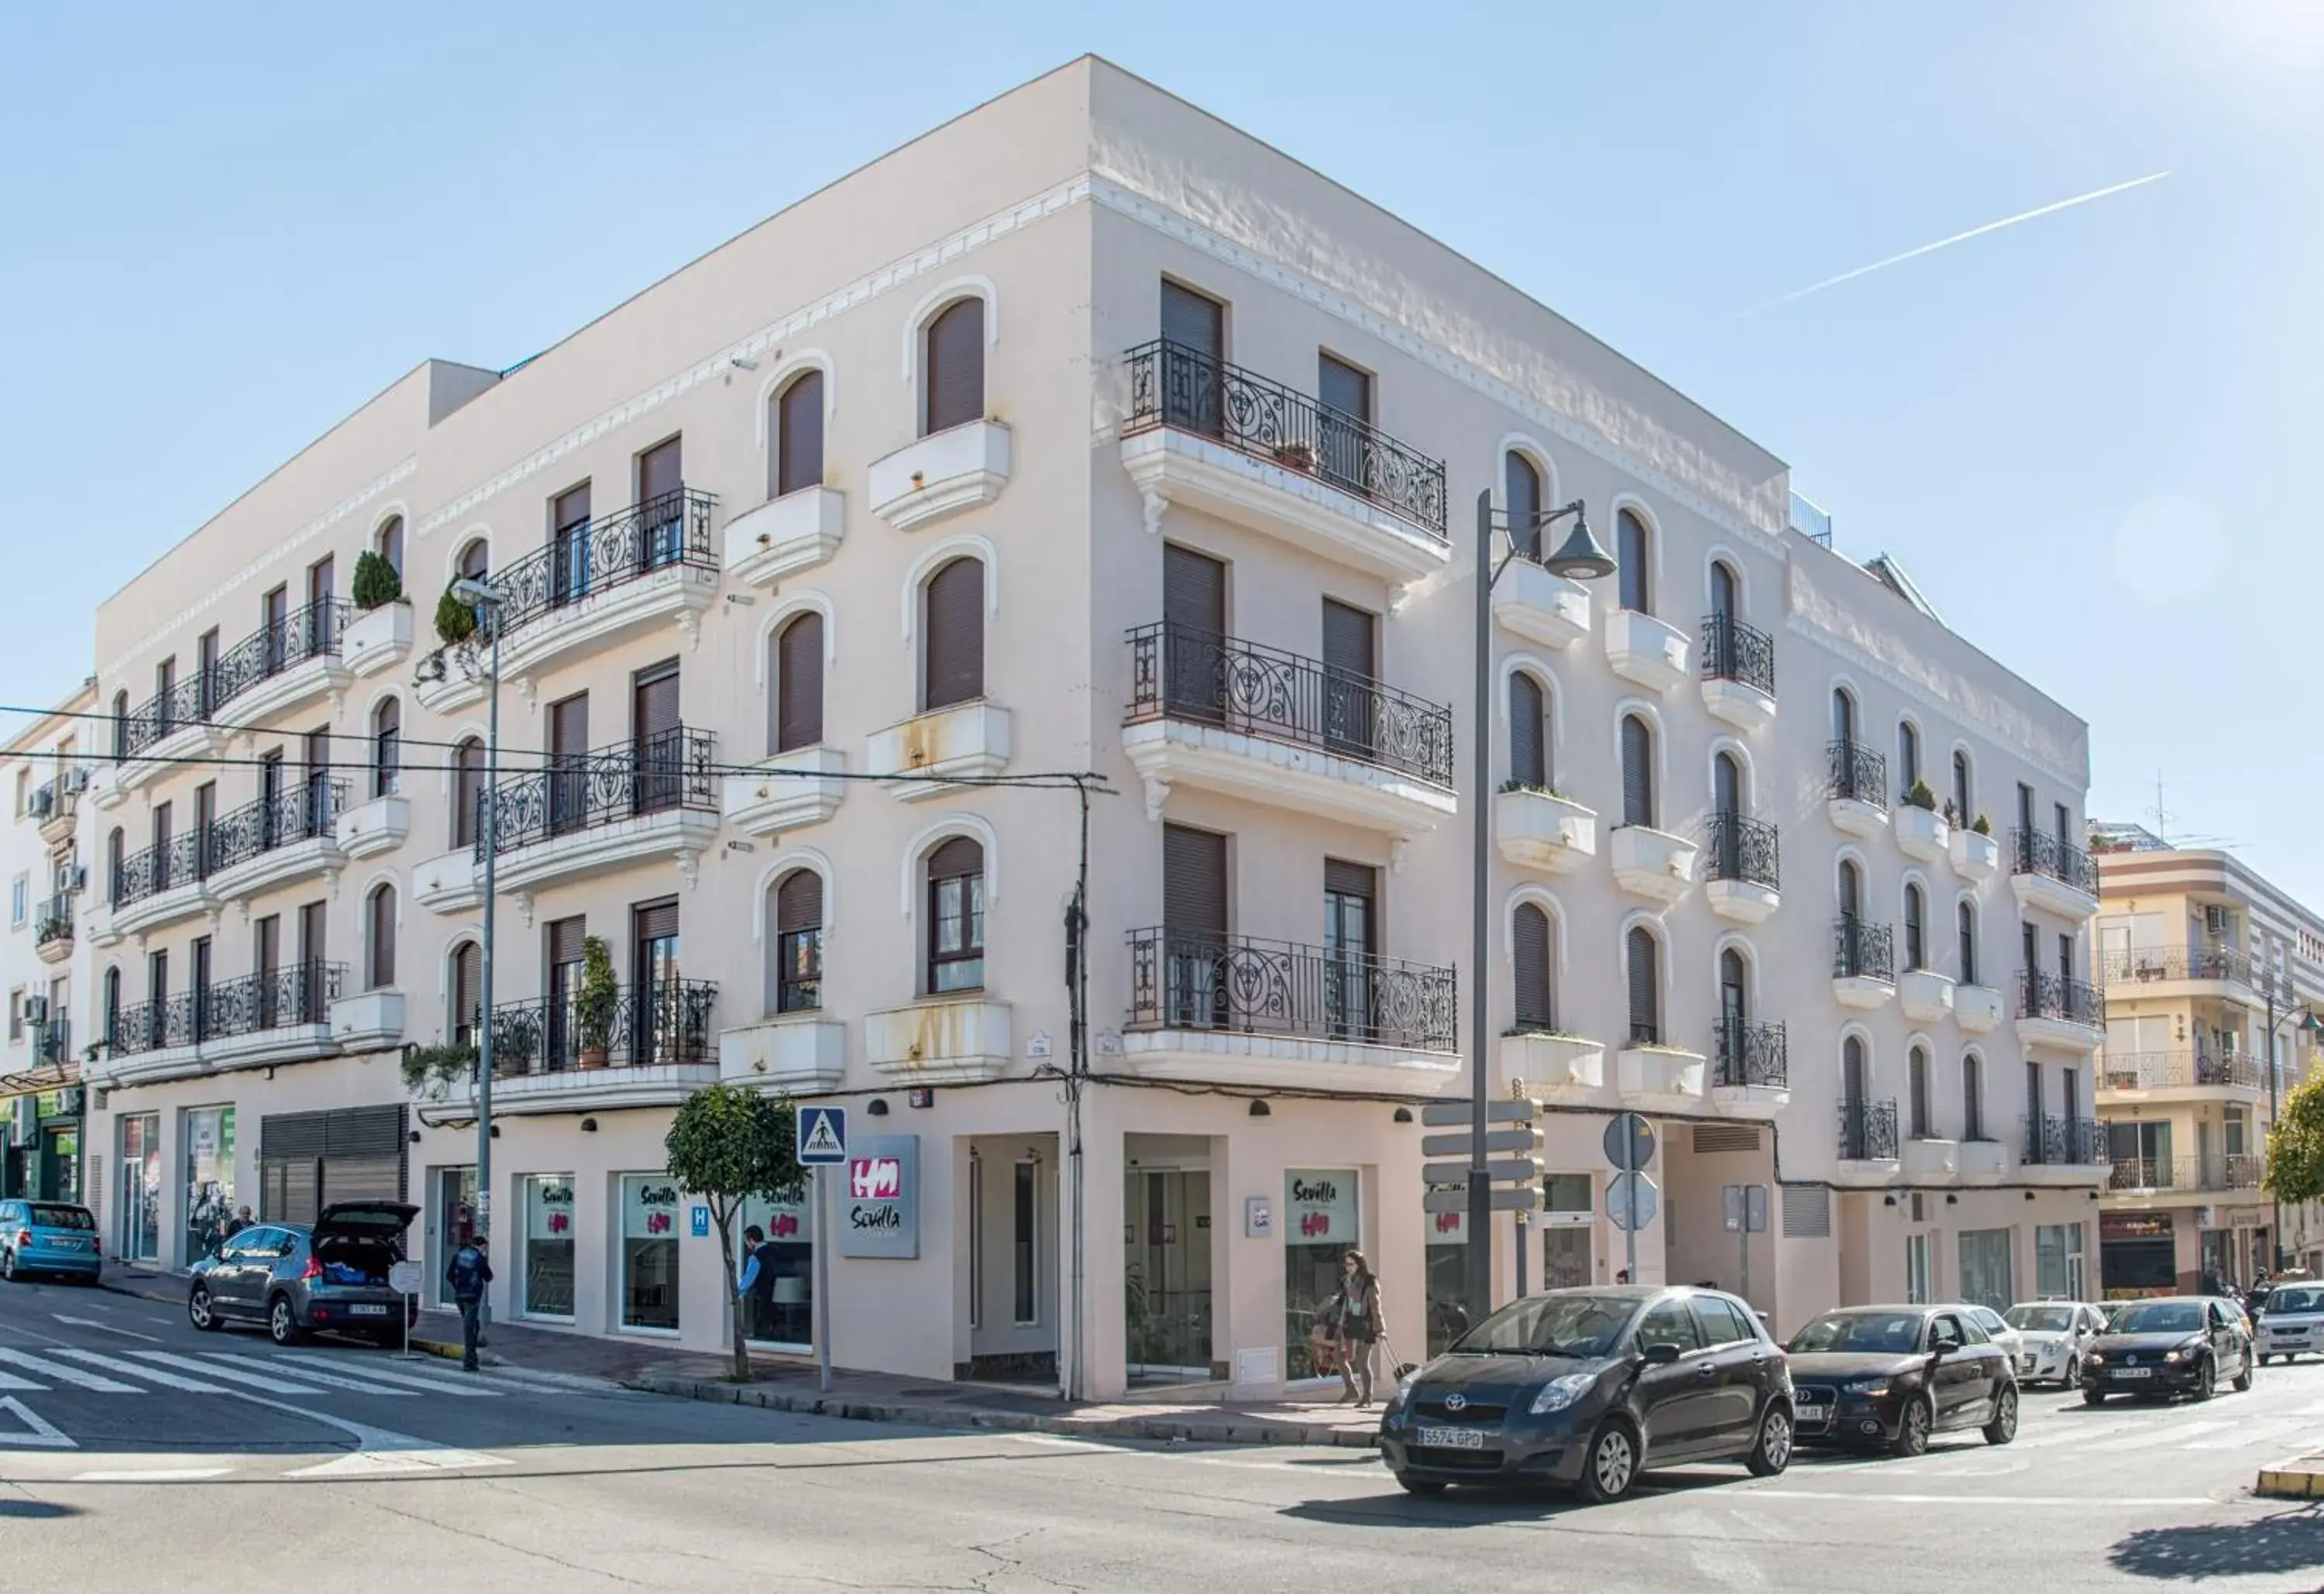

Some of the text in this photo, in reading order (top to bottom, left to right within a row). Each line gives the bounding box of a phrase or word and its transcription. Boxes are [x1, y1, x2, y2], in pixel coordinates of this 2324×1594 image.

[1293, 1179, 1336, 1202] Sevilla
[851, 1204, 900, 1229] Sevilla
[1425, 1429, 1453, 1444] 5574
